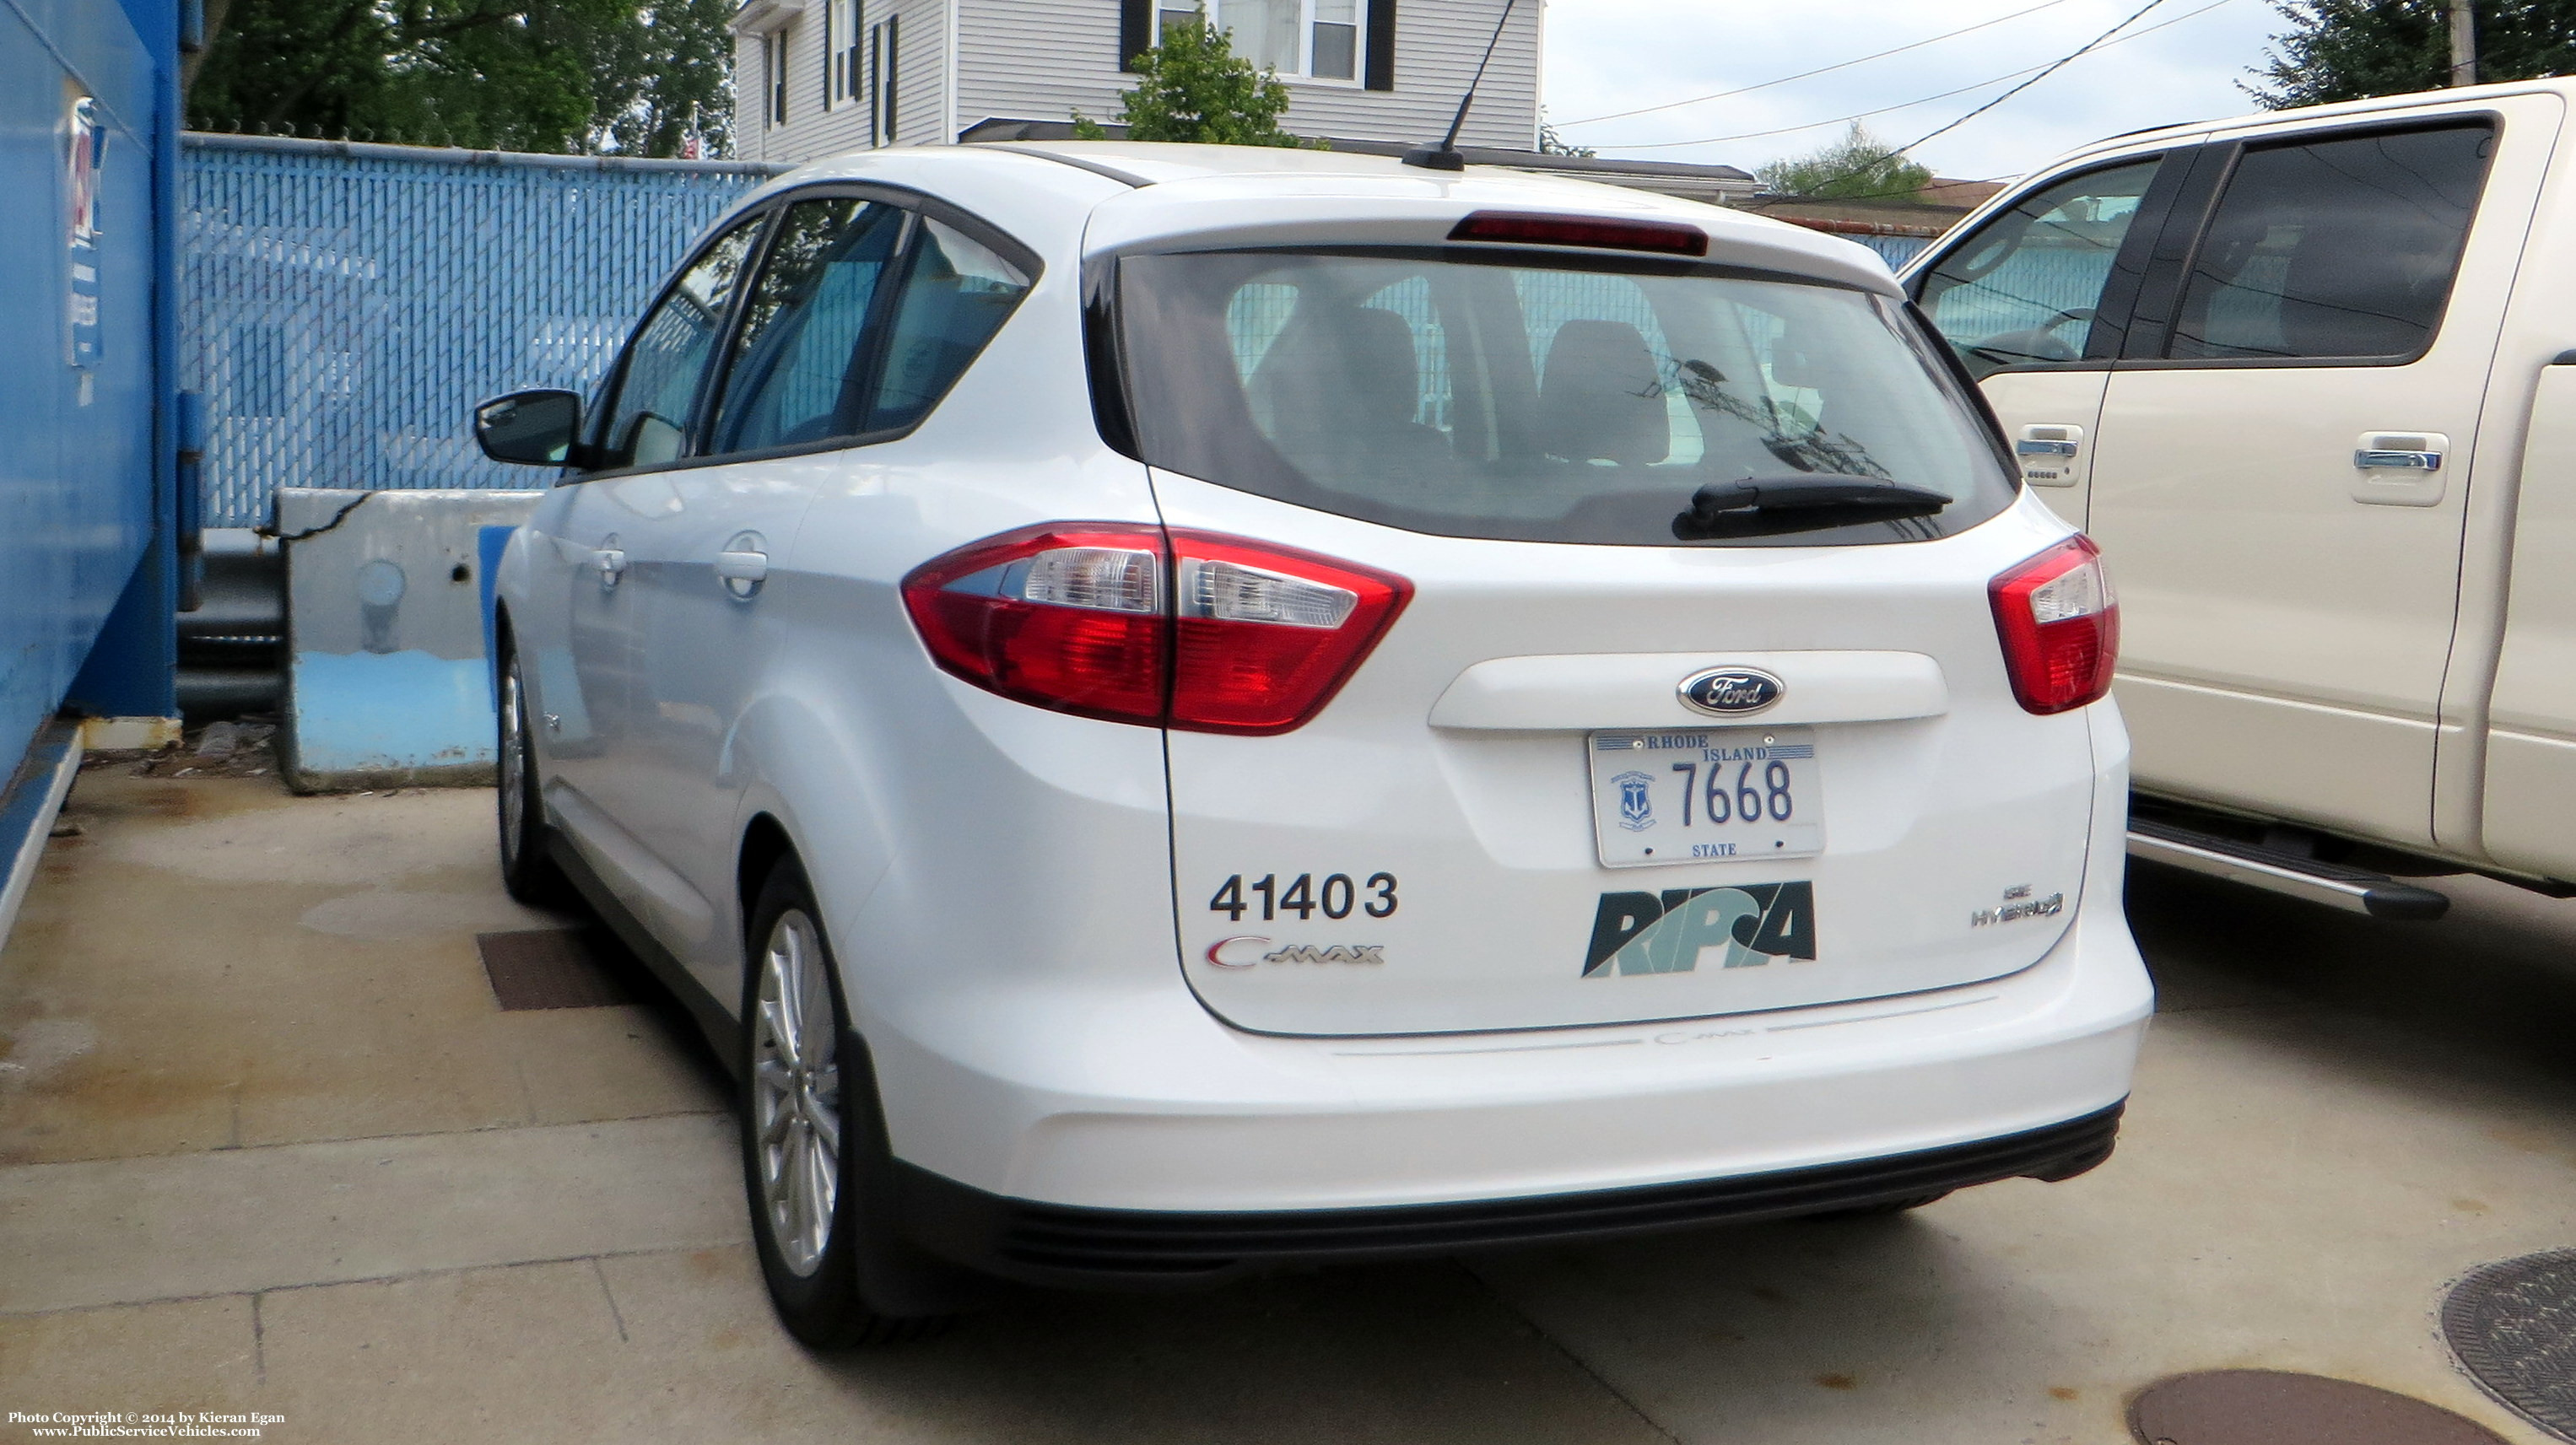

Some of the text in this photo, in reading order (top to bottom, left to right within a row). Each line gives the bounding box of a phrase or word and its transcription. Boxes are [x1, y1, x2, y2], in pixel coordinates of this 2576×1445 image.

[1706, 676, 1763, 705] Ford
[1648, 735, 1709, 749] RHODE
[1703, 747, 1767, 762] ISLAND
[1672, 759, 1793, 827] 7668
[1693, 844, 1736, 857] STATE
[1209, 871, 1399, 921] 41403
[1581, 880, 1817, 978] RIPTA
